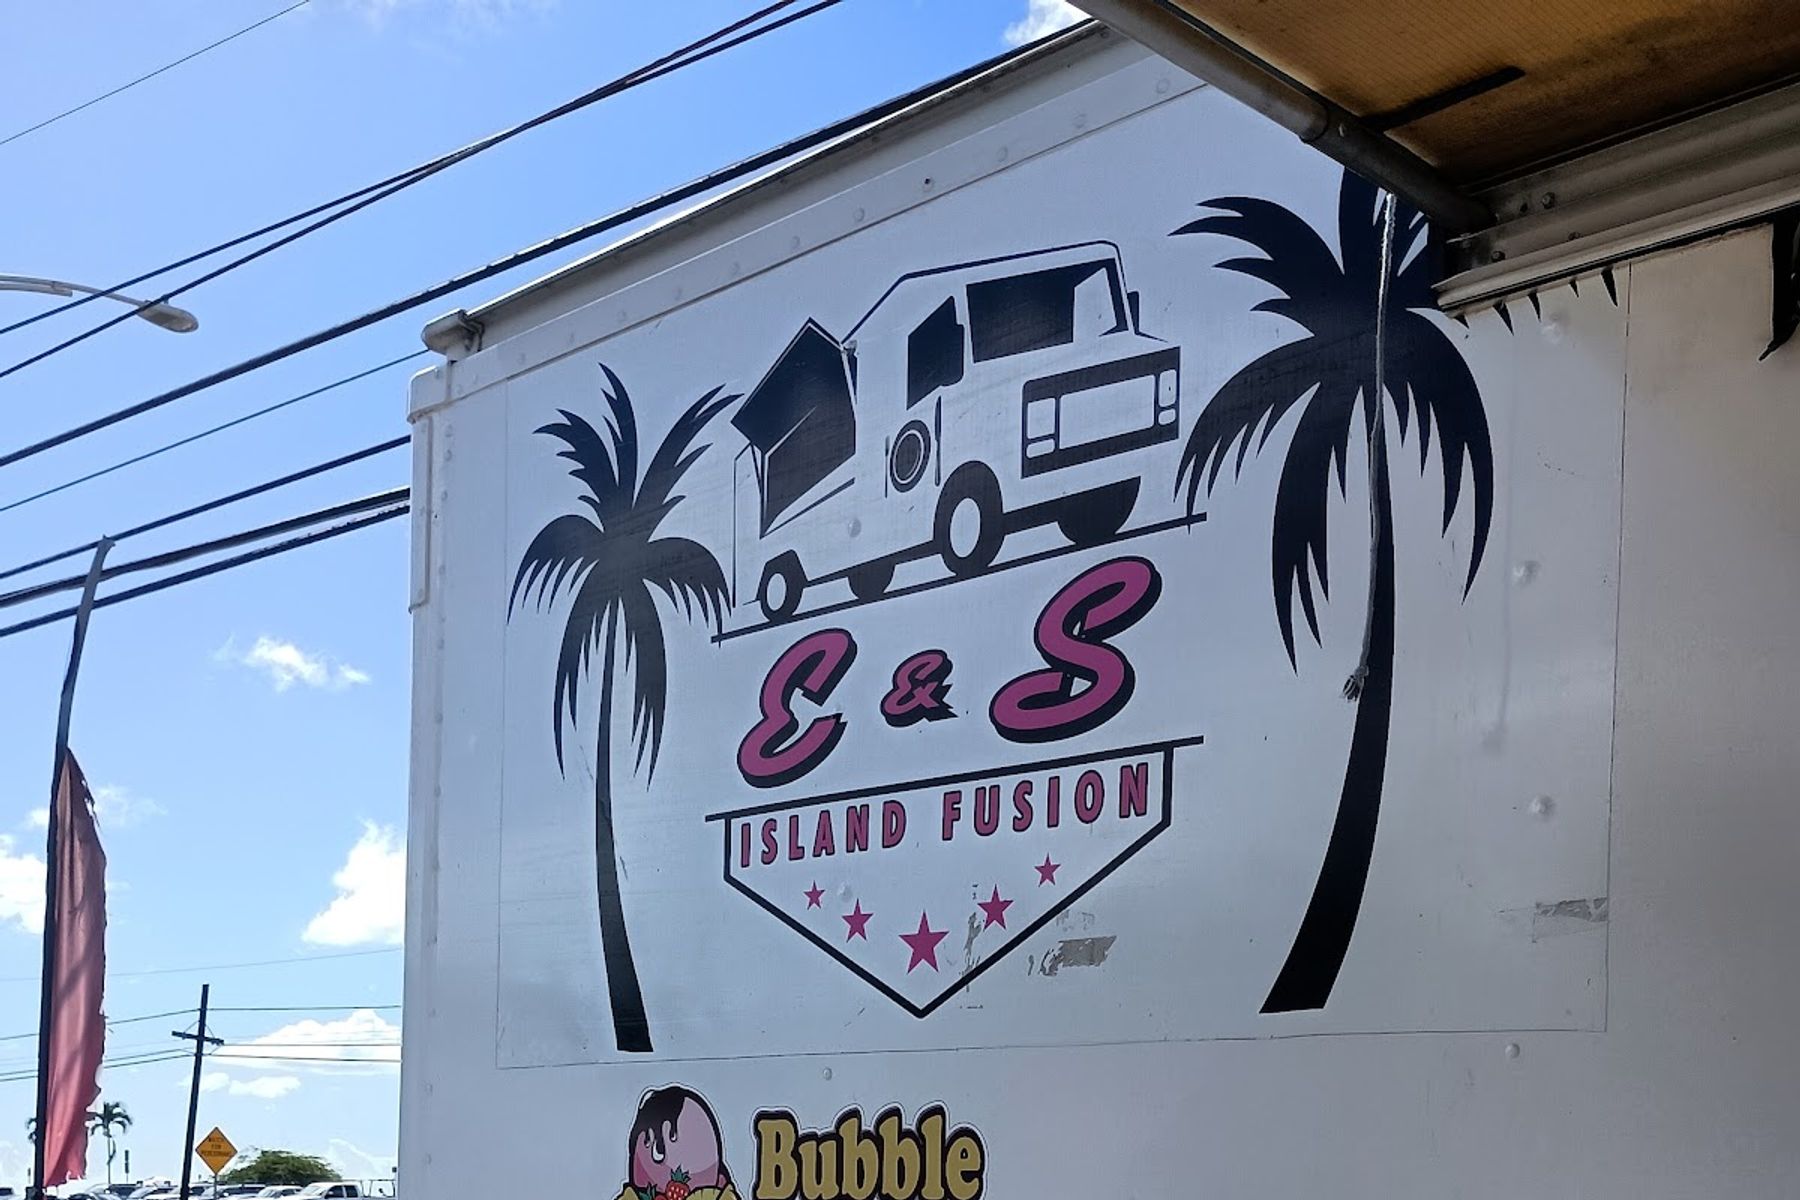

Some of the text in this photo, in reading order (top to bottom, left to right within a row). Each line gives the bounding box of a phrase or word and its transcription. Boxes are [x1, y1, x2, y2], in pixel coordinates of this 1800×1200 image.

[737, 555, 1162, 788] E & S
[740, 762, 1149, 868] ISLAND FUSION
